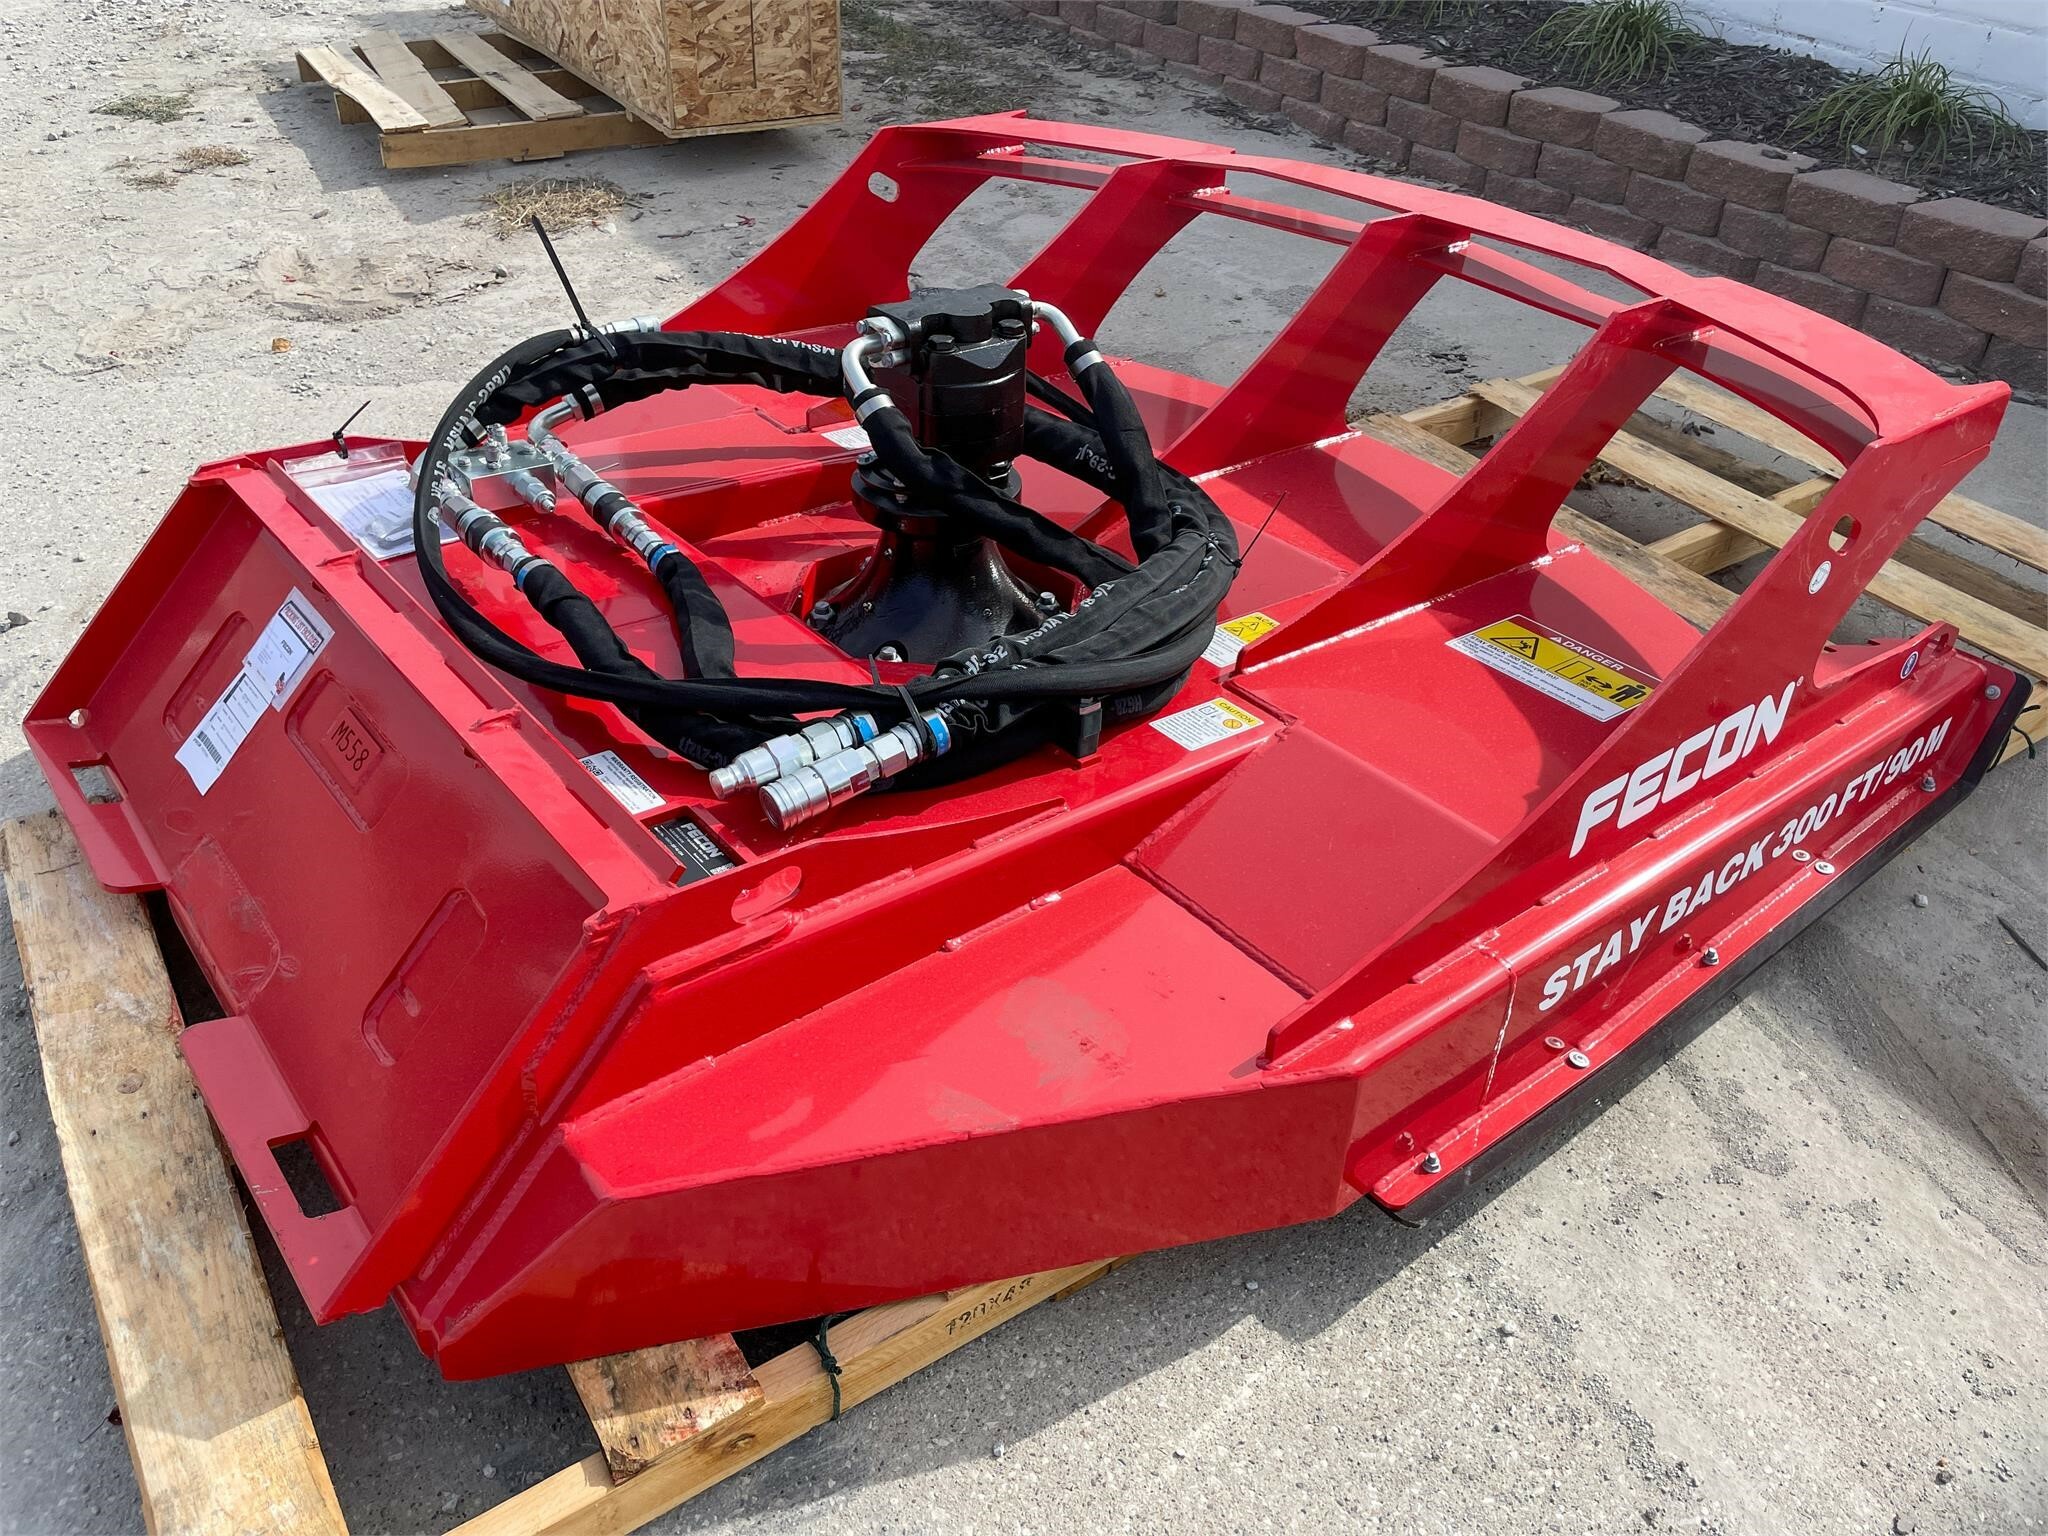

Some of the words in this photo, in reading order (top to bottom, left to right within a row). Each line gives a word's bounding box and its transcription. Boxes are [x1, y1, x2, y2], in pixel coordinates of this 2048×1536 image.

[1487, 644, 1506, 655] BACK
[1562, 640, 1624, 671] DANGER
[1220, 702, 1256, 723] CAUTION
[331, 720, 370, 771] M558
[1568, 681, 1796, 859] FECON
[680, 822, 724, 858] FECON
[1538, 904, 1660, 1012] STAY
[1659, 830, 1776, 935] BACK
[1772, 792, 1837, 858] 300
